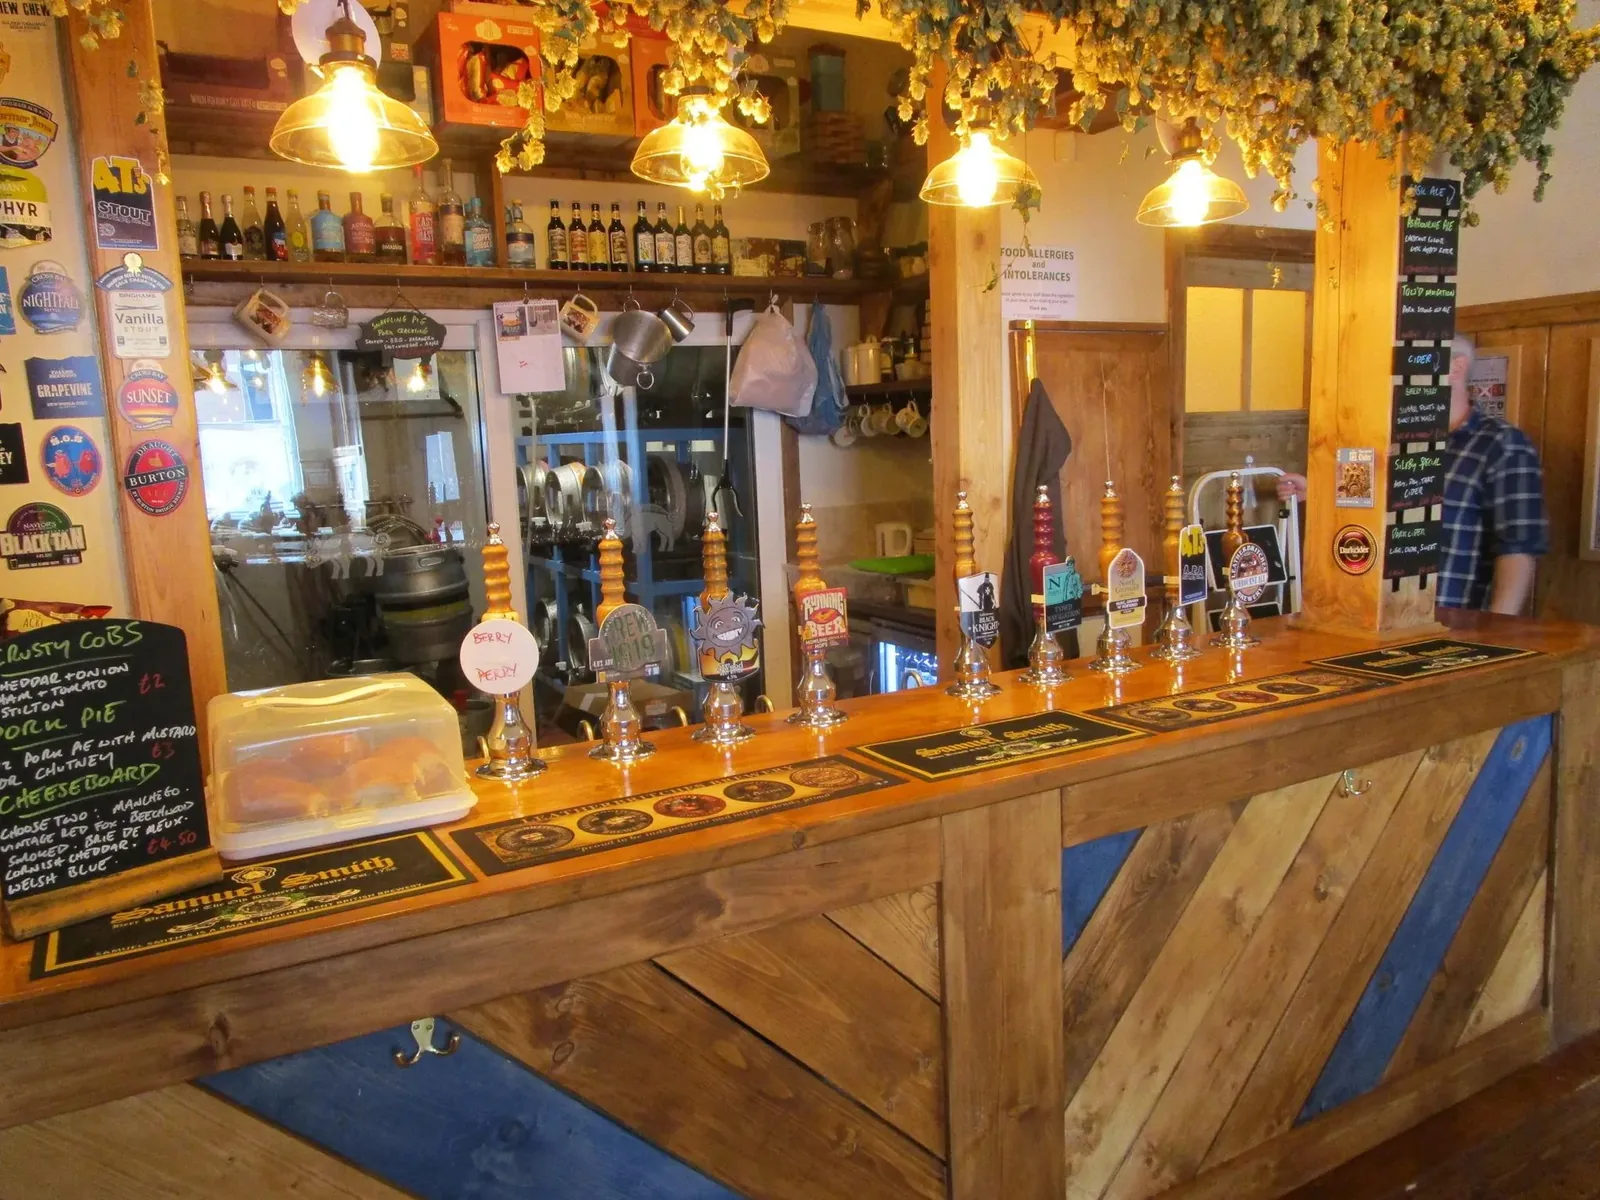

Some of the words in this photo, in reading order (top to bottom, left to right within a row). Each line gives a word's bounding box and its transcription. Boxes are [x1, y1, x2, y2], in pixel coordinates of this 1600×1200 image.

[1429, 186, 1447, 197] ALE
[97, 200, 152, 223] STOUT
[1000, 247, 1026, 258] FOOD
[1027, 248, 1075, 261] ALLERGIES
[1032, 260, 1046, 269] and
[1003, 270, 1071, 282] INTOLERANCES
[23, 291, 80, 309] NIGHTFALL
[115, 312, 165, 325] Vanilla
[1408, 354, 1432, 364] CIDER
[37, 383, 94, 398] GRAPEVINE
[126, 388, 172, 404] SUNSET
[136, 441, 178, 456] DRAUGHT
[129, 467, 186, 486] BURTON
[1403, 486, 1424, 499] CIDER
[54, 526, 84, 551] TAN
[1231, 544, 1267, 579] LEATHERBRITCHES
[1047, 575, 1061, 591] N
[1236, 587, 1264, 602] BREWERY
[803, 592, 845, 621] RUNNING
[803, 616, 846, 641] BEER
[972, 620, 999, 633] KNIGHT
[979, 615, 995, 623] BLACK
[79, 621, 143, 650] COBS
[473, 631, 513, 645] BERRY
[138, 672, 166, 695] £2
[475, 663, 517, 683] PERRY
[50, 679, 107, 697] TOMATO
[1, 699, 65, 719] STILTON
[80, 700, 127, 728] PIE
[24, 749, 63, 768] PORK
[71, 739, 95, 757] PIE
[99, 731, 136, 748] WITH
[141, 725, 197, 743] MUSTARD
[915, 735, 1004, 759] Samuel
[1003, 722, 1074, 741] Smith
[152, 743, 175, 760] £3
[0, 775, 22, 790] OR
[35, 751, 115, 781] CHUTNEY
[0, 762, 161, 815] CHEESEBOARD
[519, 782, 706, 826] LEATHERBRITCHES
[709, 763, 795, 785] BREWERY
[0, 818, 52, 841] CHOOSE
[54, 811, 88, 828] TWO
[112, 785, 180, 815] MANCHEGO
[0, 832, 56, 853] VINTAGE
[60, 825, 89, 839] RED
[94, 819, 118, 832] FOX
[129, 800, 195, 824] BEECHWOOD
[8, 843, 71, 868] SMOKED
[84, 831, 117, 849] BRIE
[122, 826, 140, 839] DE
[4, 857, 66, 882] CORNISH
[7, 873, 58, 896] WELSH
[67, 855, 113, 879] BLUE
[111, 880, 269, 926] Samuel
[280, 855, 397, 889] Smith
[112, 919, 140, 930] Beer
[144, 910, 187, 924] Brewed
[299, 875, 347, 891] Tadcaster
[96, 944, 141, 957] SAMUEL
[146, 932, 194, 948] SMITH'S
[260, 902, 334, 923] INDEPENDENT
[336, 893, 376, 907] BRITISH
